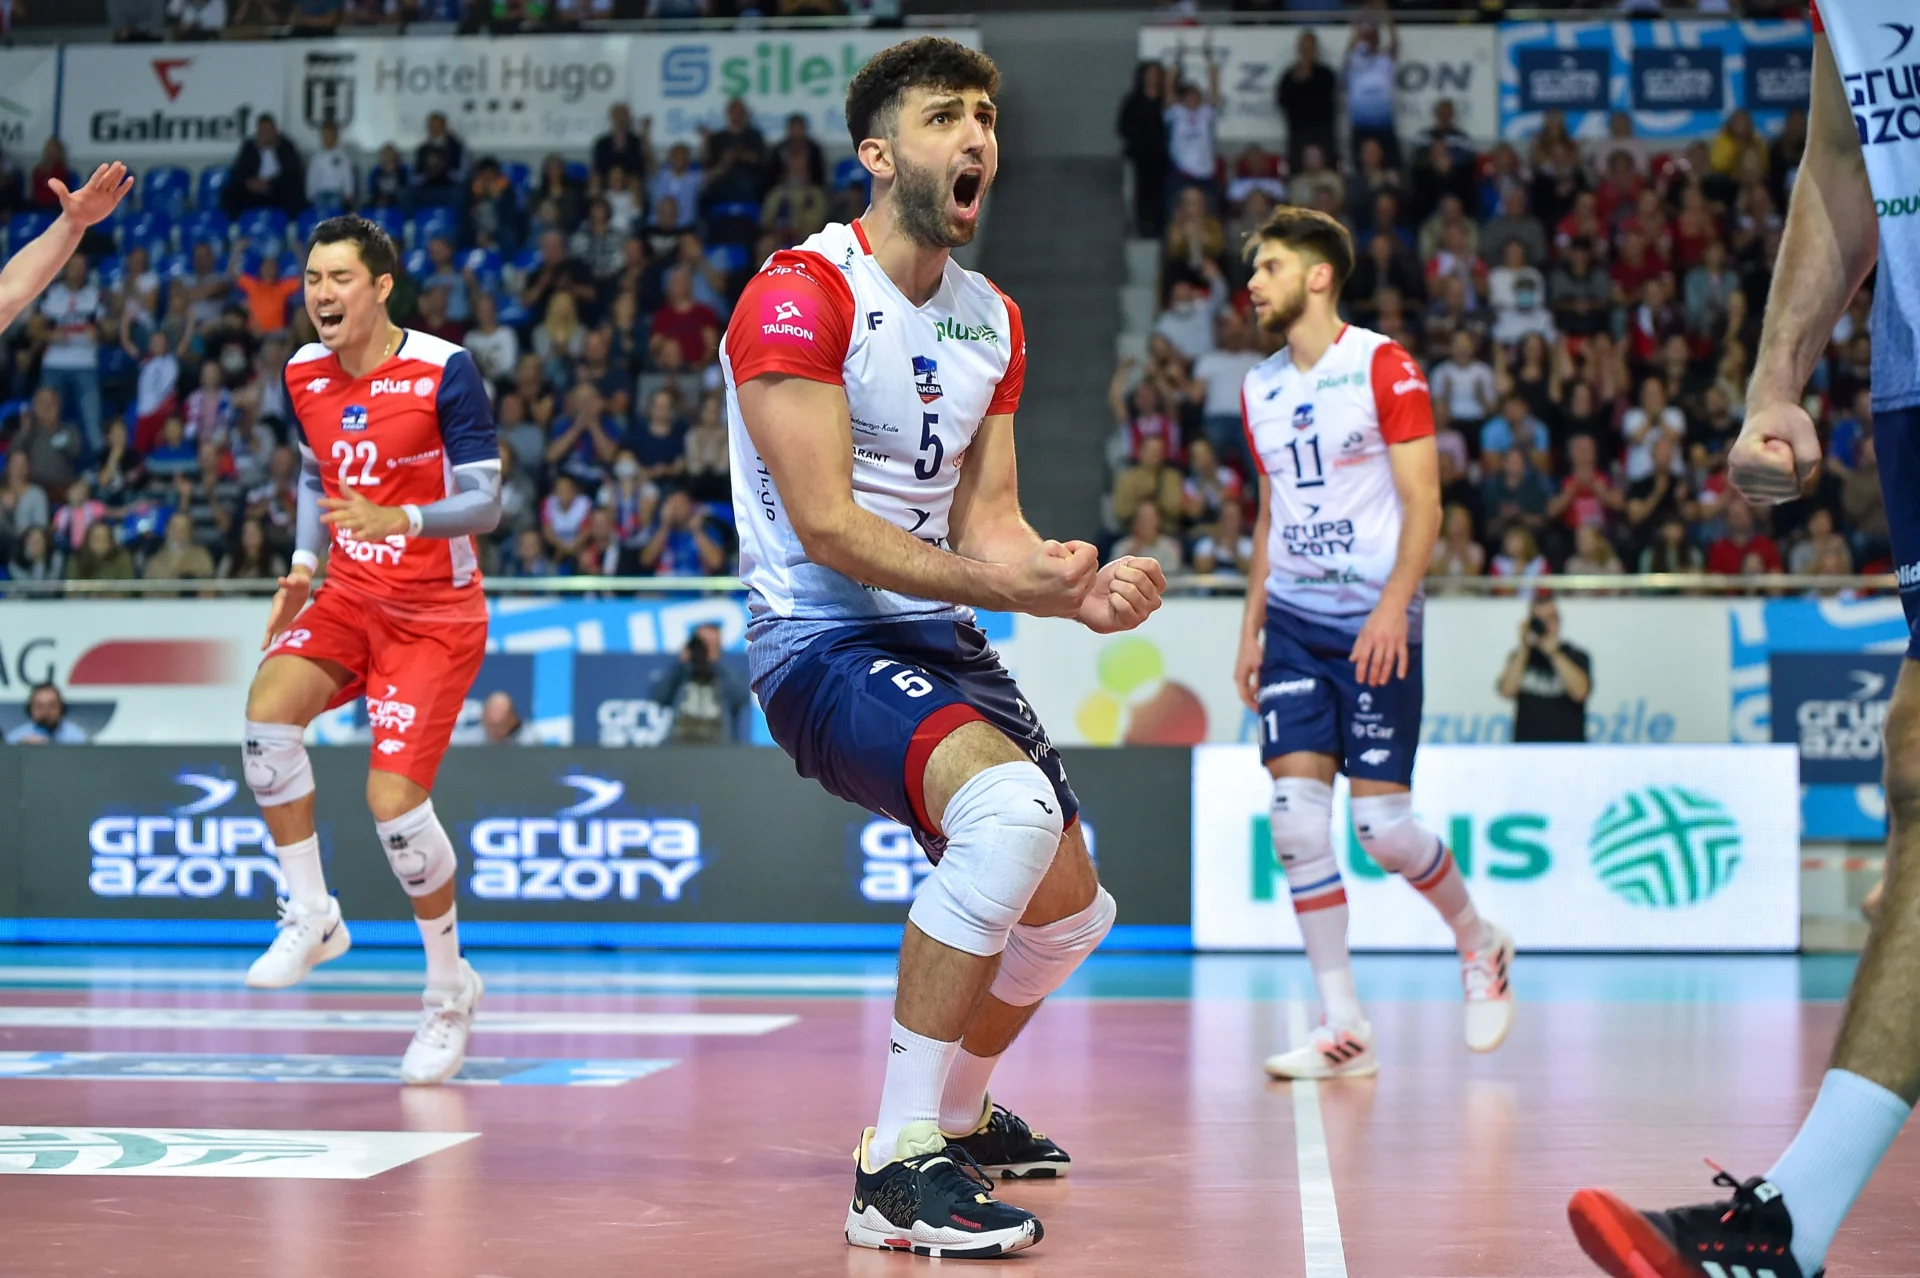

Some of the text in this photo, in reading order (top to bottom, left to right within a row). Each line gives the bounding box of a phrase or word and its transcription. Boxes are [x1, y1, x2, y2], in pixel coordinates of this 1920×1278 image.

[375, 55, 615, 103] Hotel Hugo
[90, 107, 251, 143] Galmet
[762, 323, 813, 341] TAURON
[866, 311, 883, 330] F
[933, 317, 979, 342] plus
[370, 378, 411, 396] plus
[914, 411, 944, 480] 5
[331, 440, 381, 486] 22
[891, 669, 934, 698] 5
